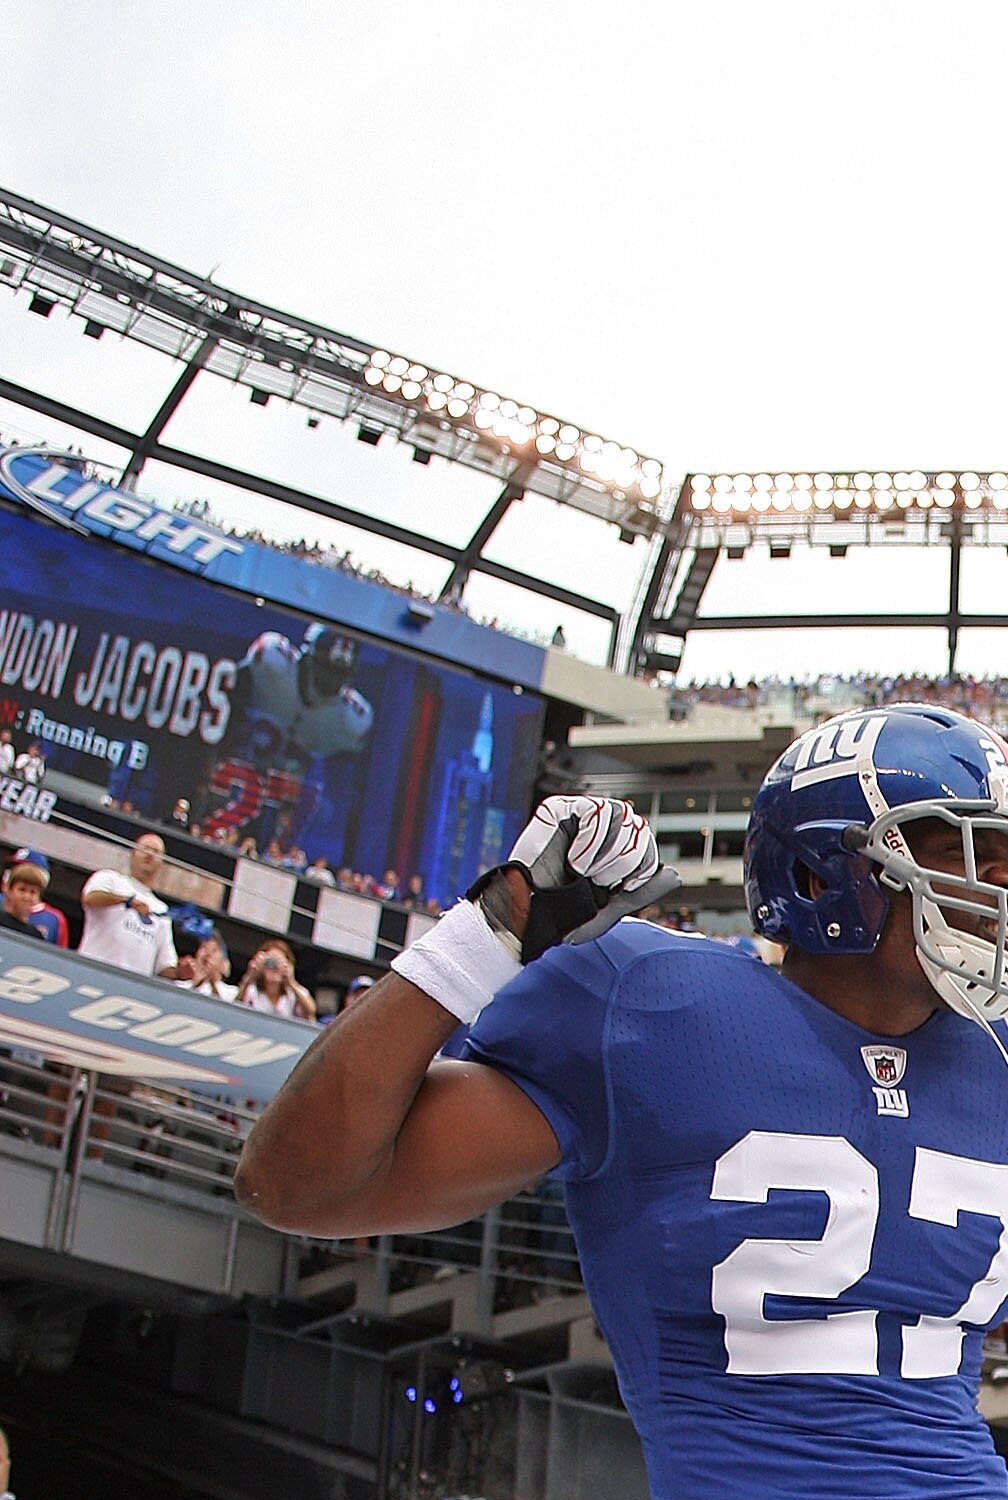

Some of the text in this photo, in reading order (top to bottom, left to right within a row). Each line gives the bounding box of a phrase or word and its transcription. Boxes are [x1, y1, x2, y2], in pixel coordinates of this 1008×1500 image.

[26, 464, 245, 564] LIGHT
[74, 632, 238, 744] JACOBS
[26, 708, 126, 768] Running
[128, 740, 149, 770] B
